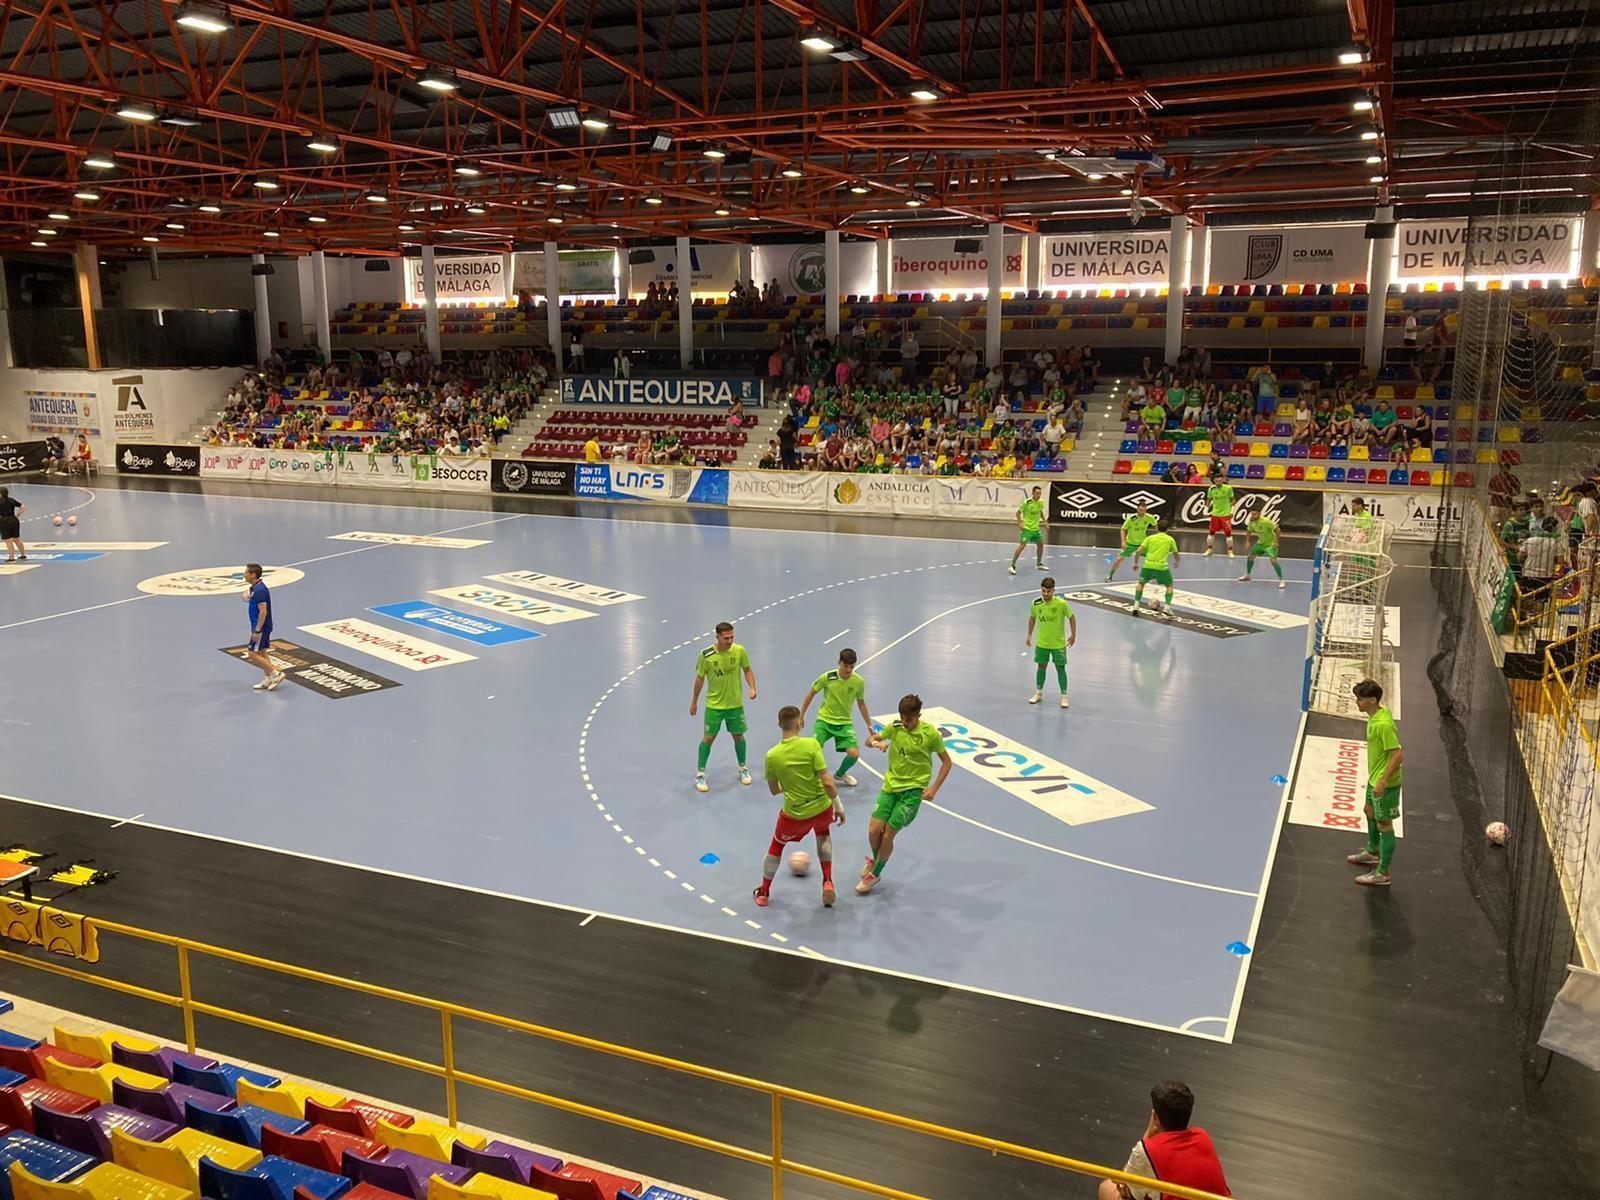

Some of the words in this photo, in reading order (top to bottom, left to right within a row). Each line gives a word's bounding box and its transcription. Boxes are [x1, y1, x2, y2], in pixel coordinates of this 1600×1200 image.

[1405, 224, 1569, 246] UNIVERSIDAD
[1052, 239, 1169, 257] UNIVERSIDA
[1293, 249, 1307, 257] CD
[1310, 249, 1334, 257] UMA
[893, 252, 989, 275] iberoquino
[1051, 262, 1076, 277] DE
[1082, 258, 1166, 276] MÁLAGA
[1404, 252, 1434, 269] DE
[416, 262, 501, 276] UVERSIDAD
[436, 277, 492, 292] MÁLAGA
[578, 379, 734, 405] ANTEQUERA
[29, 398, 78, 415] ANTEQUERA
[48, 415, 58, 425] DEL
[58, 416, 79, 426] DEPORTE
[431, 467, 488, 482] BESOCCER
[531, 470, 567, 479] UNIVERSIDAD
[580, 467, 593, 475] SIN
[594, 467, 602, 475] TI
[539, 477, 562, 486] MÁLAGA
[579, 476, 591, 484] NO
[591, 477, 607, 485] HAY
[578, 485, 608, 494] FUTSAL
[1060, 509, 1097, 519] umbro
[324, 622, 425, 658] iberoquinoa
